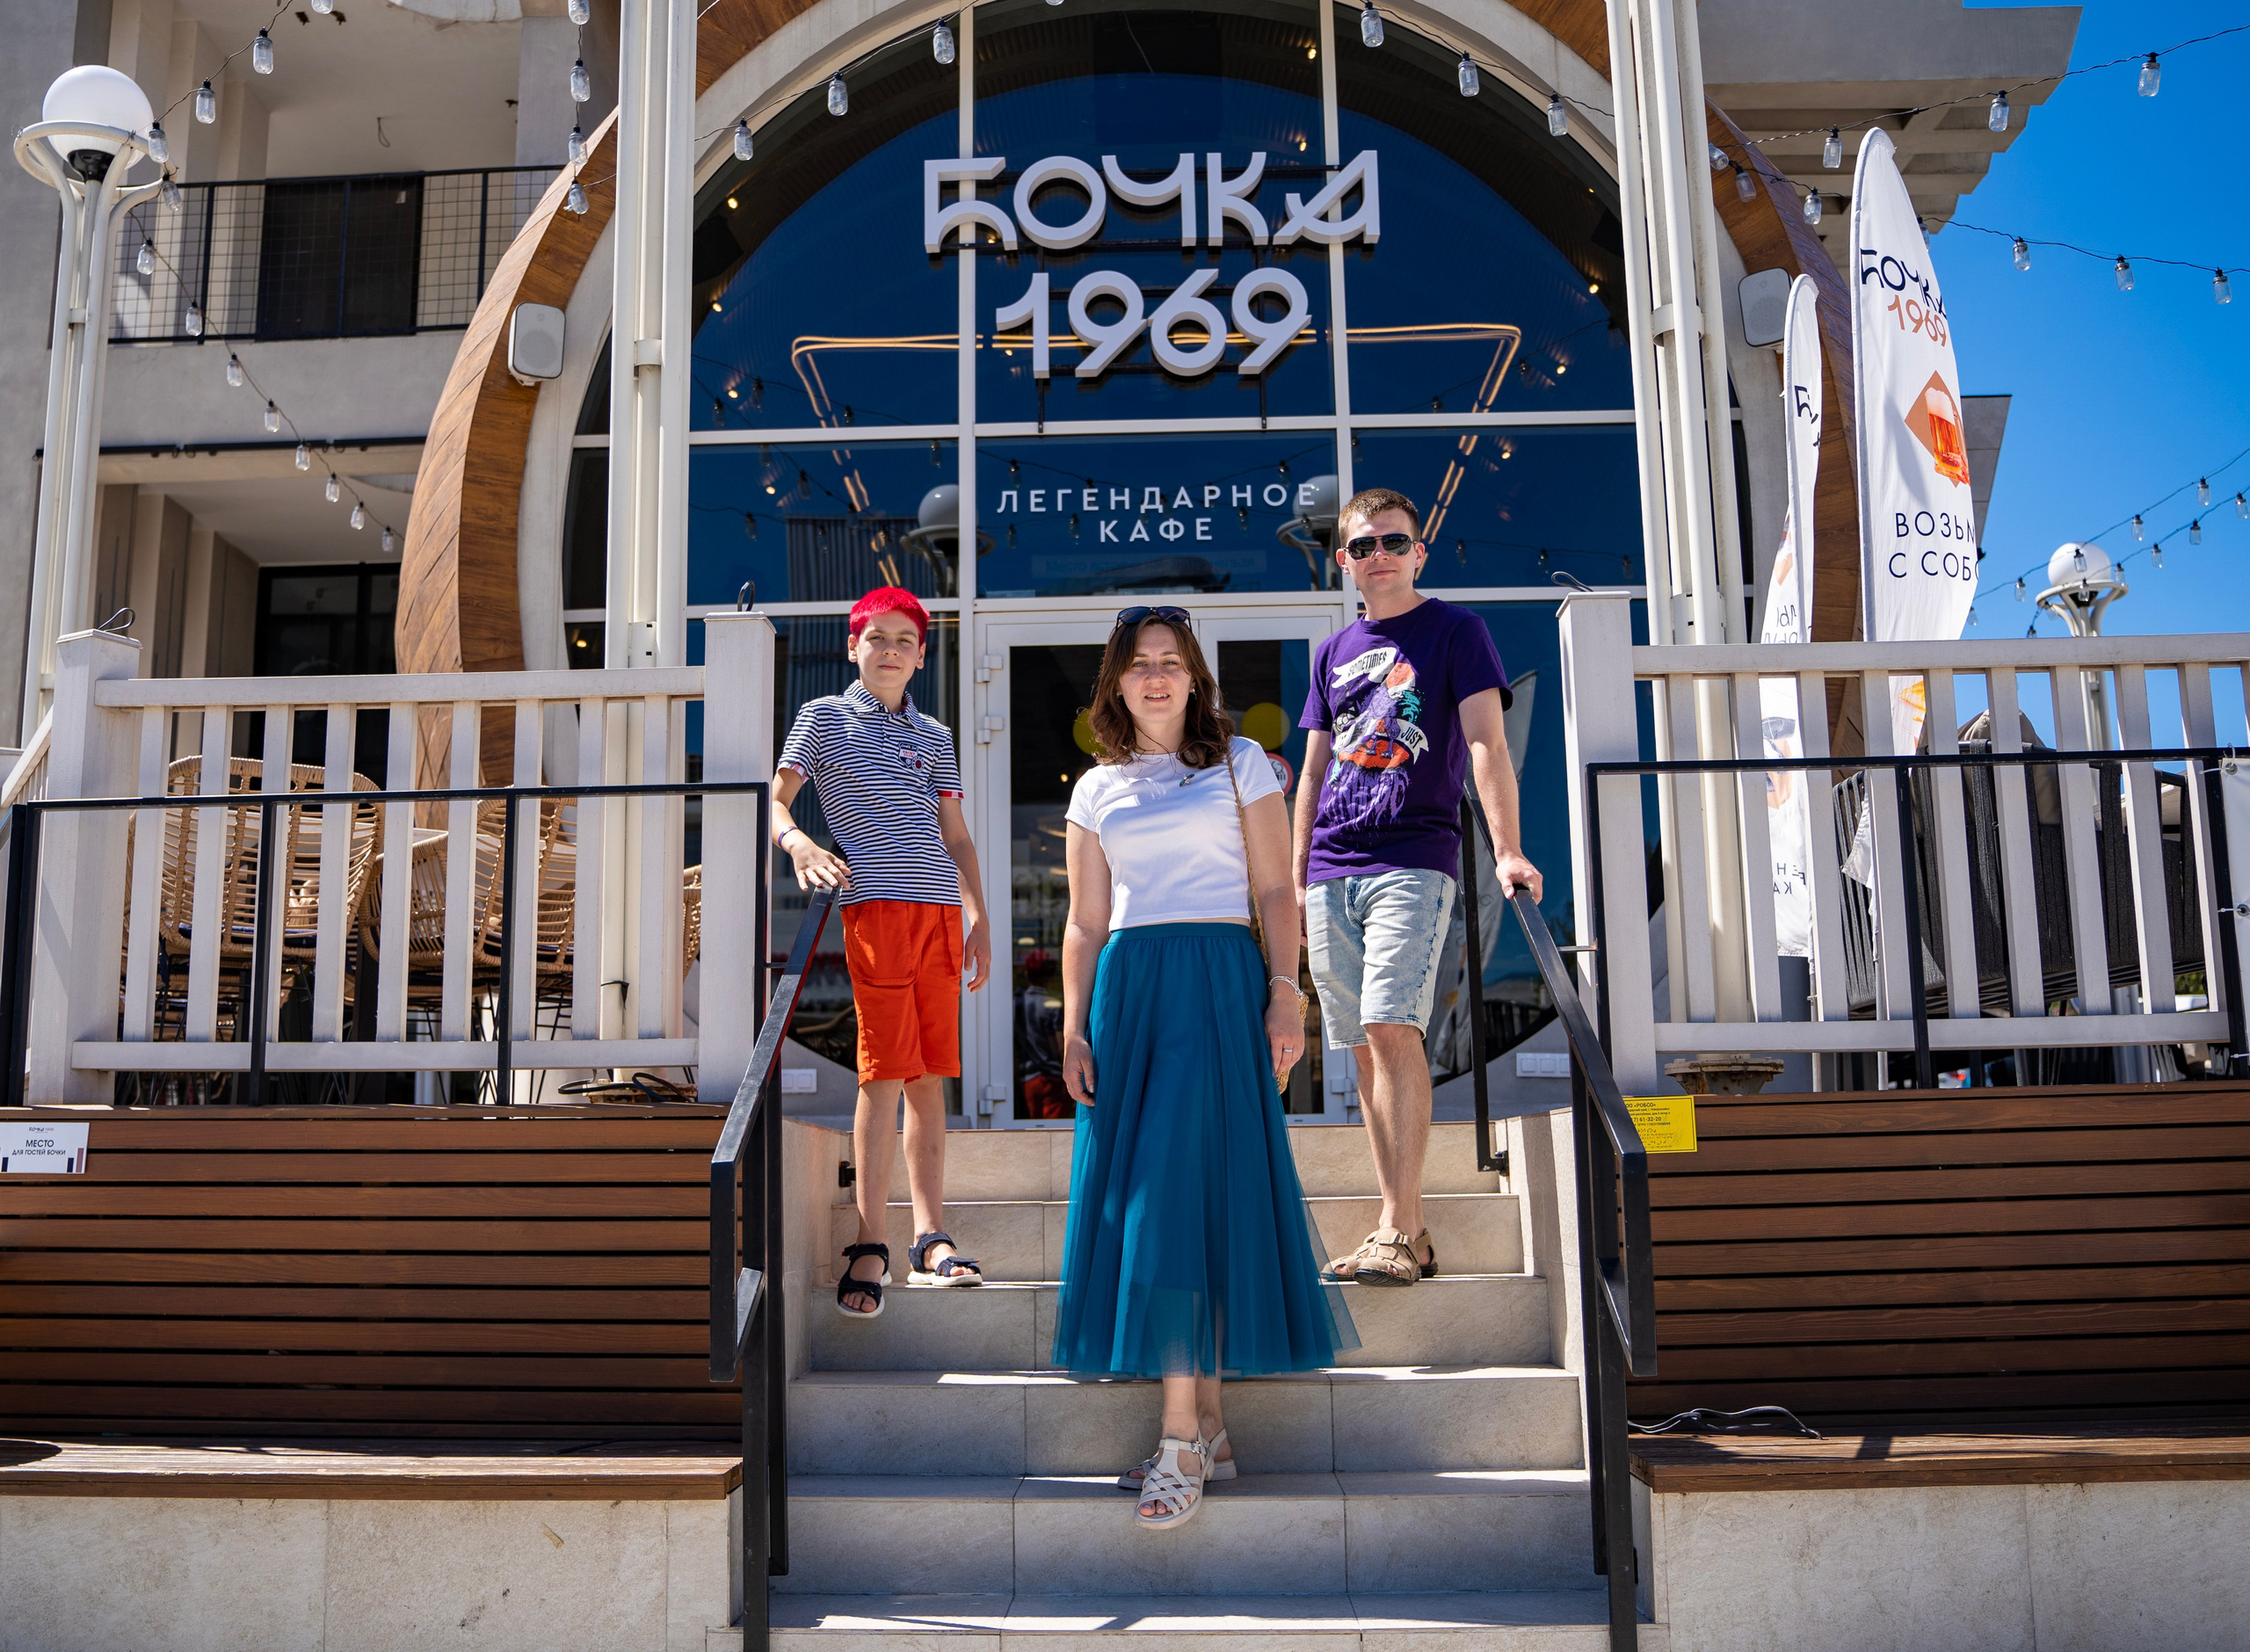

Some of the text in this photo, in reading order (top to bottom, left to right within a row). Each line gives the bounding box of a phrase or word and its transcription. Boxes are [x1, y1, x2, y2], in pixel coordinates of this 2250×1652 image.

[924, 150, 1380, 253] БОЧКА
[996, 267, 1312, 378] 1969
[1887, 294, 1947, 347] 1969
[997, 483, 1315, 514] ЛЕГЕНДАРНОЕ
[1100, 518, 1213, 543] КАФЕ
[1895, 511, 1974, 545] ВОЗЬМ
[1889, 550, 1978, 581] С СОБ
[1348, 651, 1388, 677] SOMETIMES
[1401, 727, 1424, 749] JUST
[25, 1139, 54, 1148] МЕСТО
